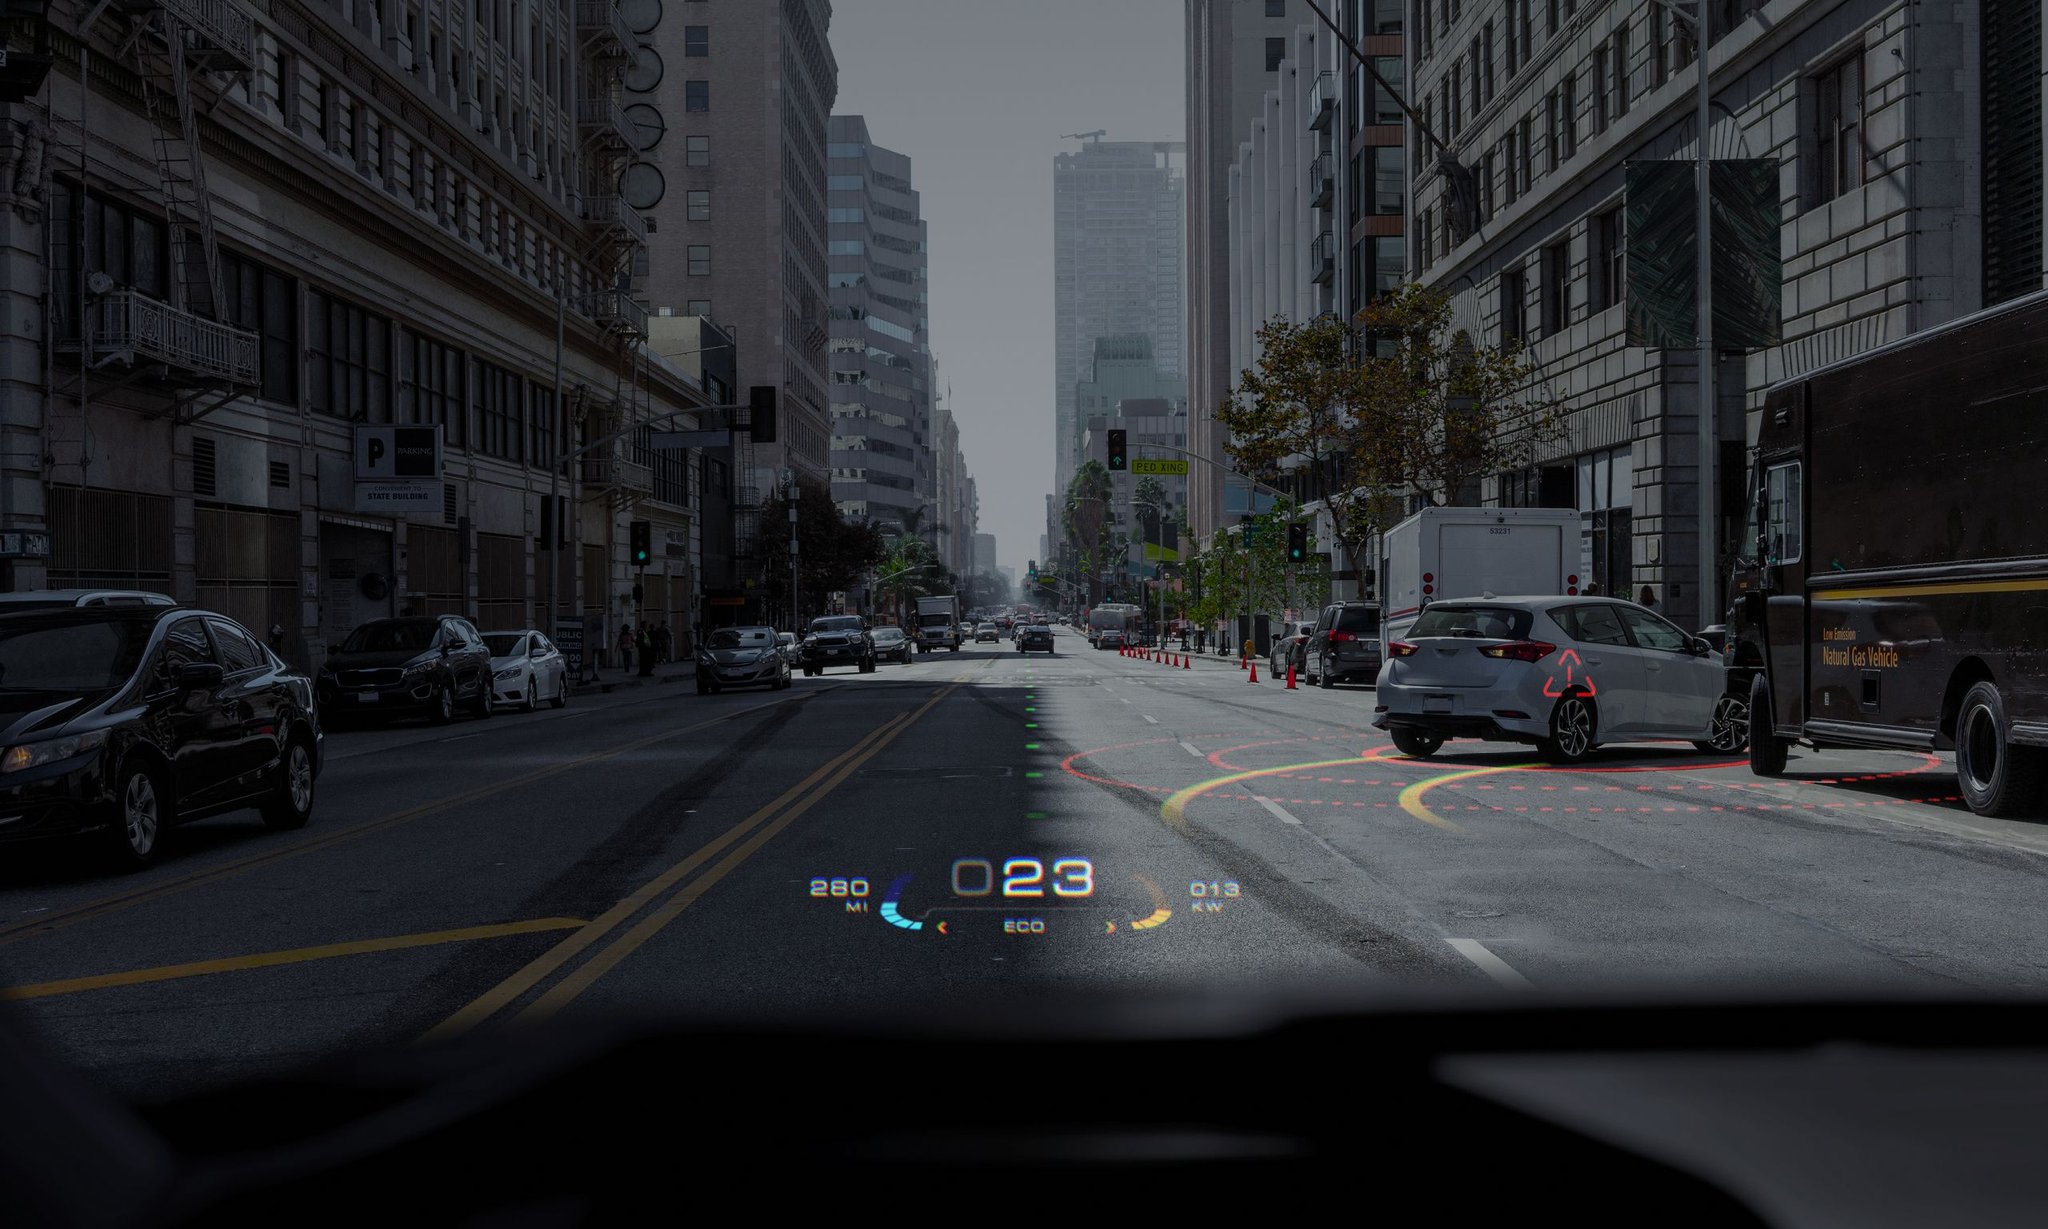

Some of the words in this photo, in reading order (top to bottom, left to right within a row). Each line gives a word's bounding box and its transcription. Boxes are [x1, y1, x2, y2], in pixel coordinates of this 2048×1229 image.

[368, 438, 384, 468] P
[397, 447, 433, 456] PARKING
[1136, 462, 1156, 472] PED
[1160, 463, 1184, 473] XING
[392, 493, 429, 501] BUILDING
[554, 631, 582, 639] UBLIC
[1823, 627, 1833, 641] Low
[1834, 627, 1857, 641] Emission
[1823, 646, 1850, 666] Natural
[1851, 646, 1866, 667] Gas
[1867, 646, 1898, 668] Vehicle
[951, 857, 1094, 897] 023
[809, 876, 870, 897] 280
[1189, 879, 1241, 898] 013
[845, 900, 868, 912] MI
[1191, 900, 1224, 912] KW
[1003, 918, 1046, 934] ECO
